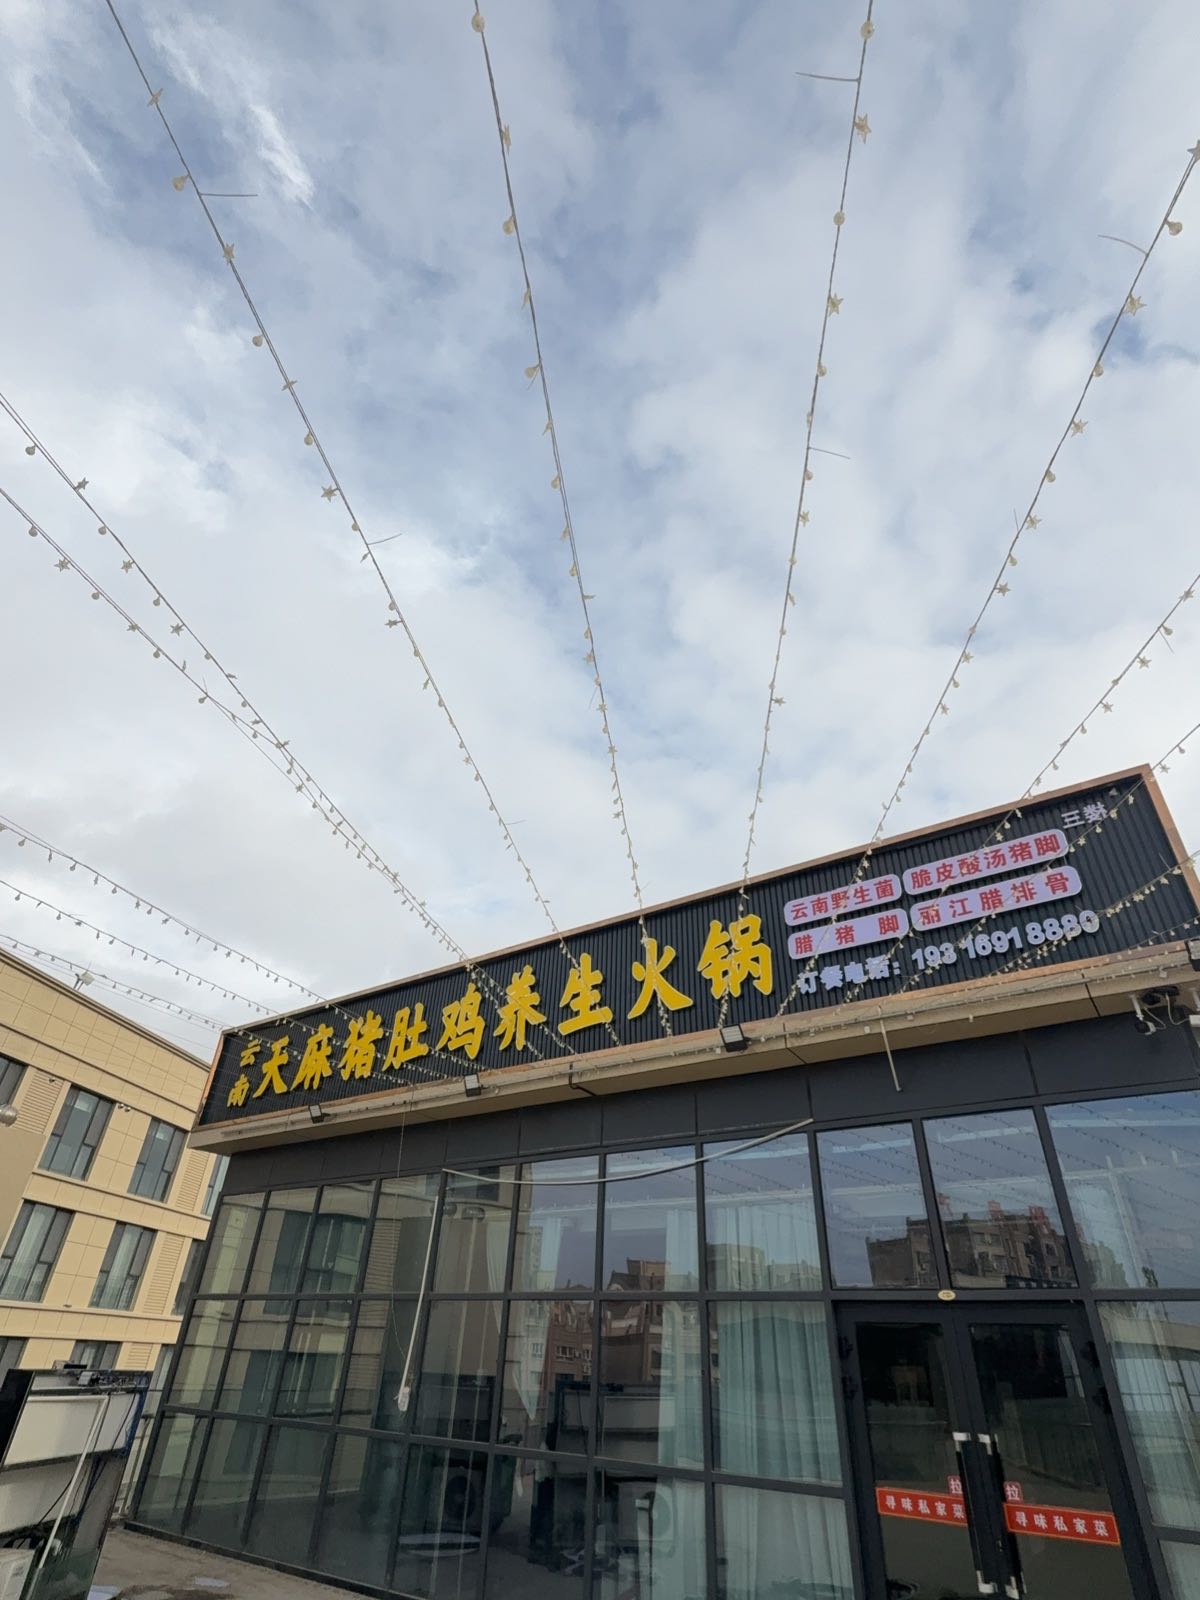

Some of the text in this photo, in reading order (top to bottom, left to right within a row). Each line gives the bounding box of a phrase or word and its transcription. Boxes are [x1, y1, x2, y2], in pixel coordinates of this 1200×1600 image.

[910, 833, 1061, 889] 脆皮酸汤猪脚
[790, 876, 896, 919] 云南野生菌
[918, 866, 1070, 926] 丽江腊排骨
[794, 913, 899, 955] 腊猪脚
[911, 942, 958, 971] 193
[963, 926, 1024, 959] 1691
[949, 1478, 963, 1494] 拉
[1004, 1484, 1020, 1500] 拉
[1015, 1511, 1108, 1537] 寻味私家菜
